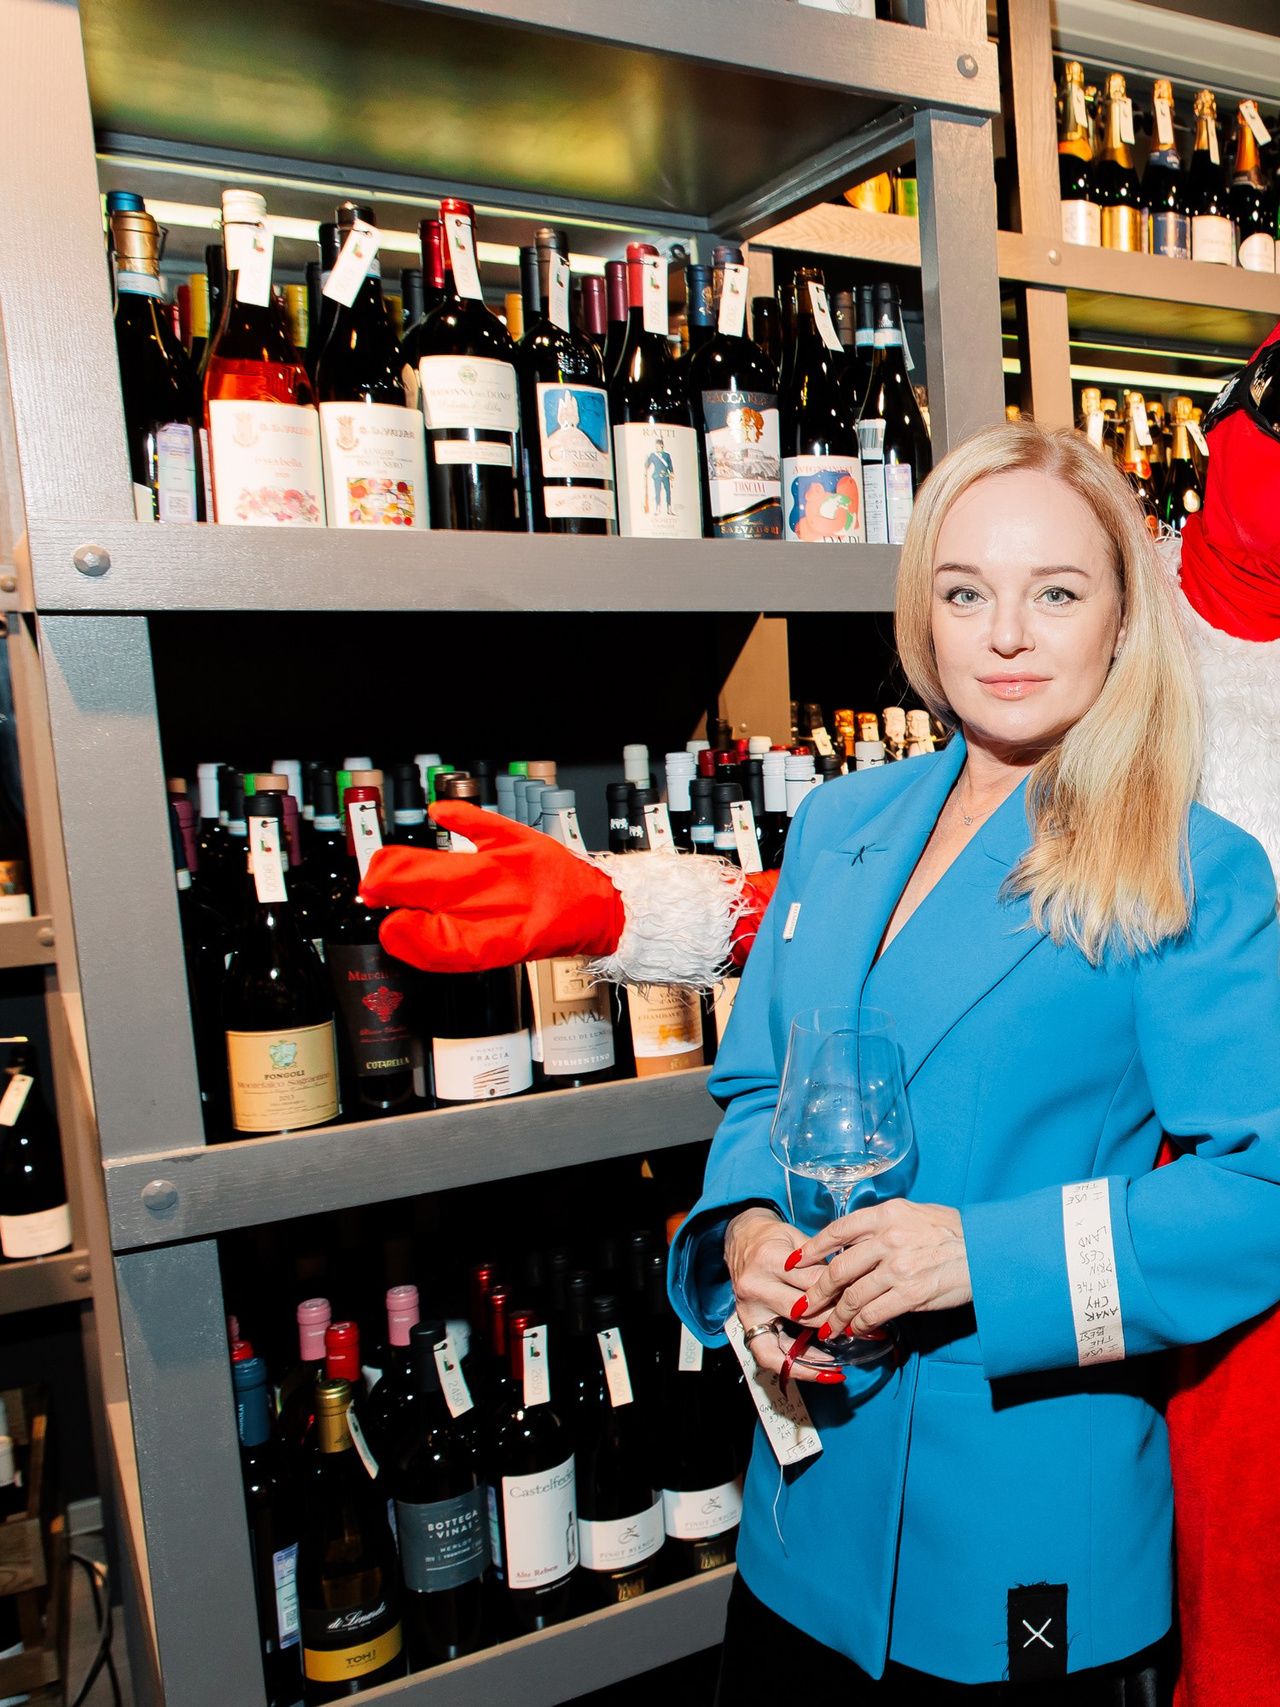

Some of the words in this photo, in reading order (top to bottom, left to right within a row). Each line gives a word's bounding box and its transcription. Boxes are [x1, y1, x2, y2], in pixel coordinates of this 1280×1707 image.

[642, 428, 676, 438] RATTI
[470, 1051, 509, 1062] FRACIA
[551, 1053, 610, 1067] VERMENTINO
[264, 1069, 305, 1080] FONGOLI
[1065, 1193, 1088, 1206] USE
[1077, 1225, 1108, 1248] LAND
[1079, 1250, 1105, 1265] CESS
[1085, 1296, 1109, 1310] CHY
[1078, 1330, 1105, 1343] BEST
[1088, 1335, 1114, 1350] THE
[684, 1338, 698, 1364] 3950
[1082, 1347, 1104, 1360] USE
[531, 1367, 543, 1396] 2650
[612, 1369, 626, 1397] 4050
[447, 1377, 465, 1408] 2450
[427, 1509, 478, 1532] BOTTEGA
[346, 1649, 377, 1665] TOH!
